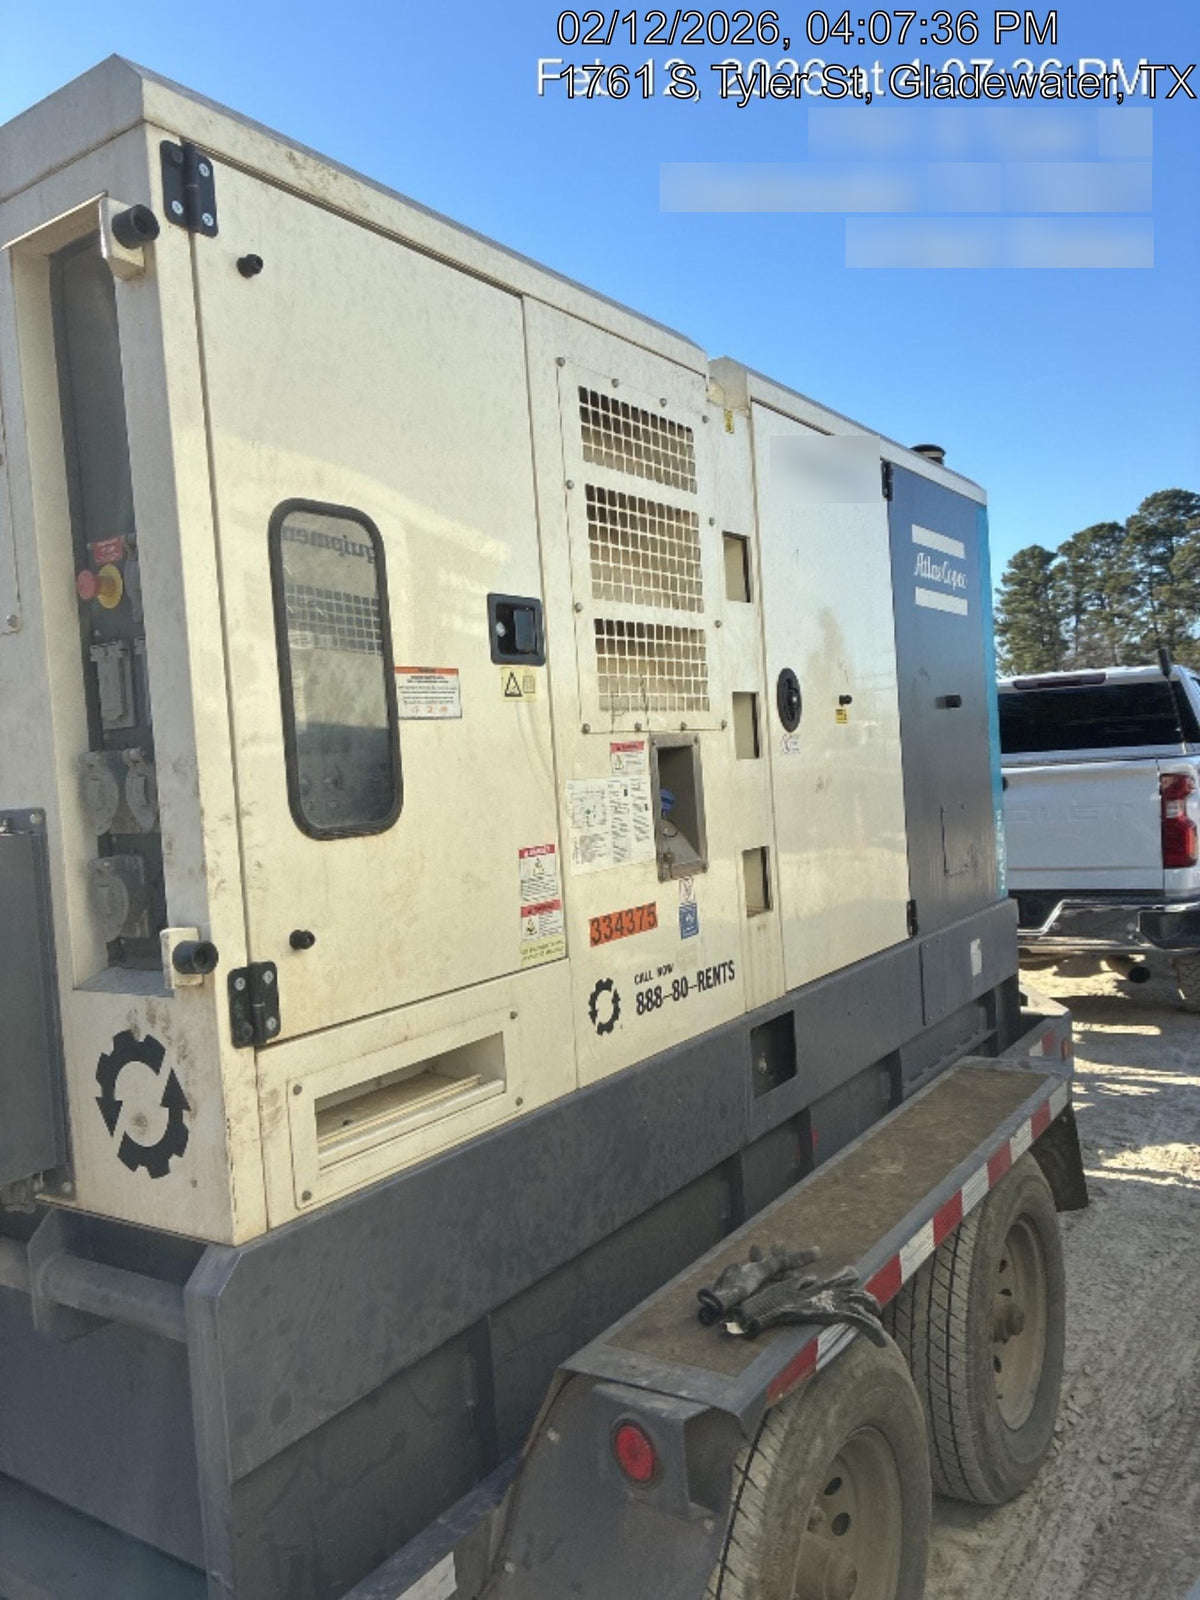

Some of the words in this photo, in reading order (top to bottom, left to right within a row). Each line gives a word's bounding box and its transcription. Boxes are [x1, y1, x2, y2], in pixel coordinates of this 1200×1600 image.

[591, 902, 658, 944] 334375
[634, 970, 653, 985] CALL
[636, 960, 735, 1015] 888-80-RENTS
